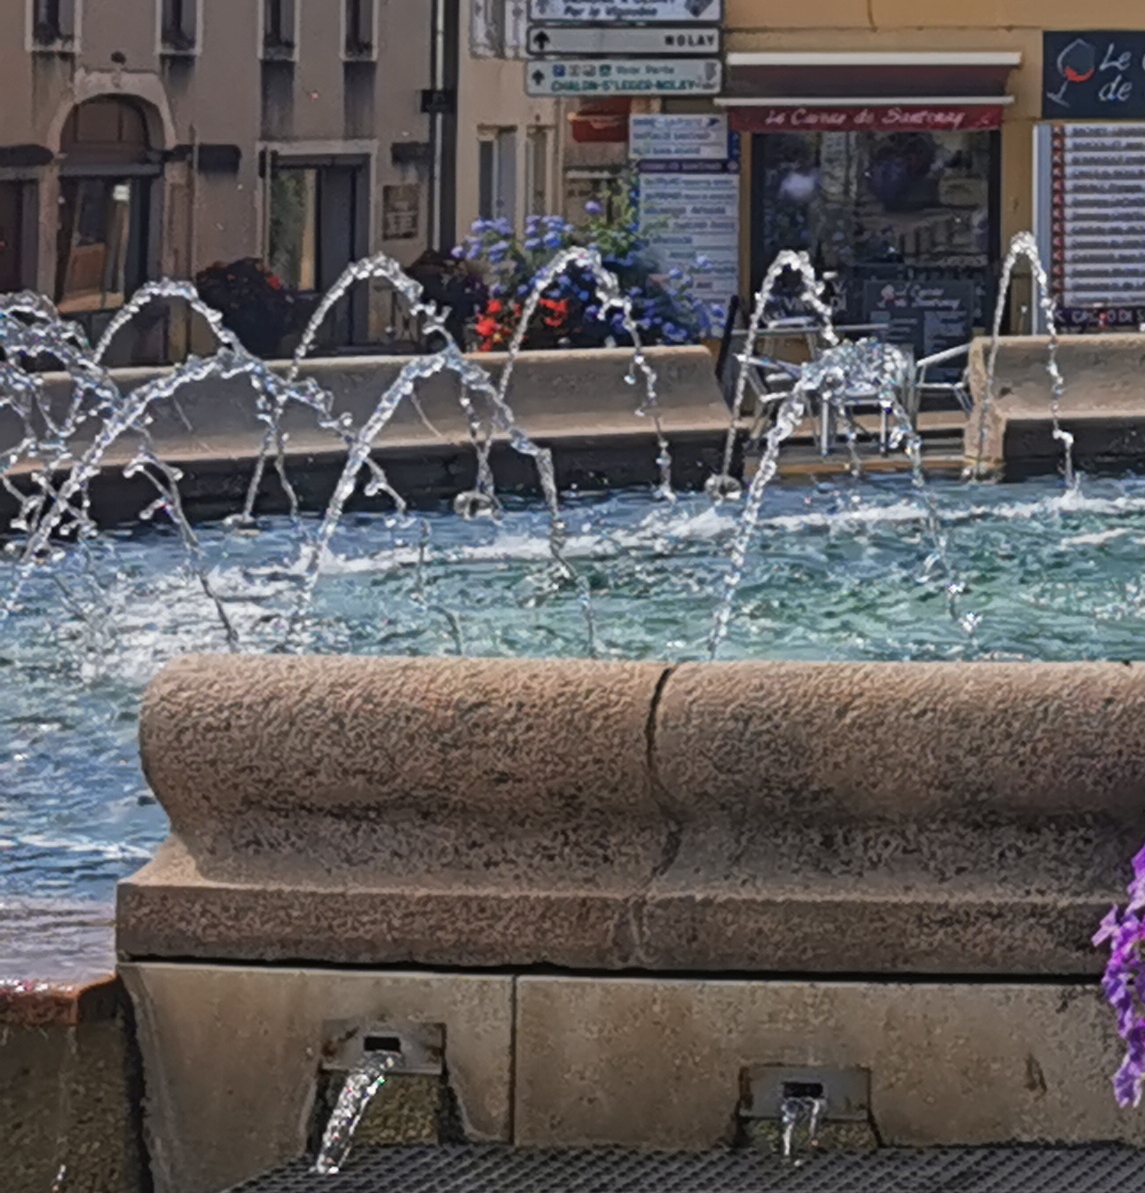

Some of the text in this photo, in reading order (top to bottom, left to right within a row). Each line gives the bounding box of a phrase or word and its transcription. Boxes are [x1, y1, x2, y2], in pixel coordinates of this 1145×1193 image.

[664, 34, 715, 47] NOLAY
[1099, 43, 1131, 70] Le
[1099, 73, 1133, 101] de
